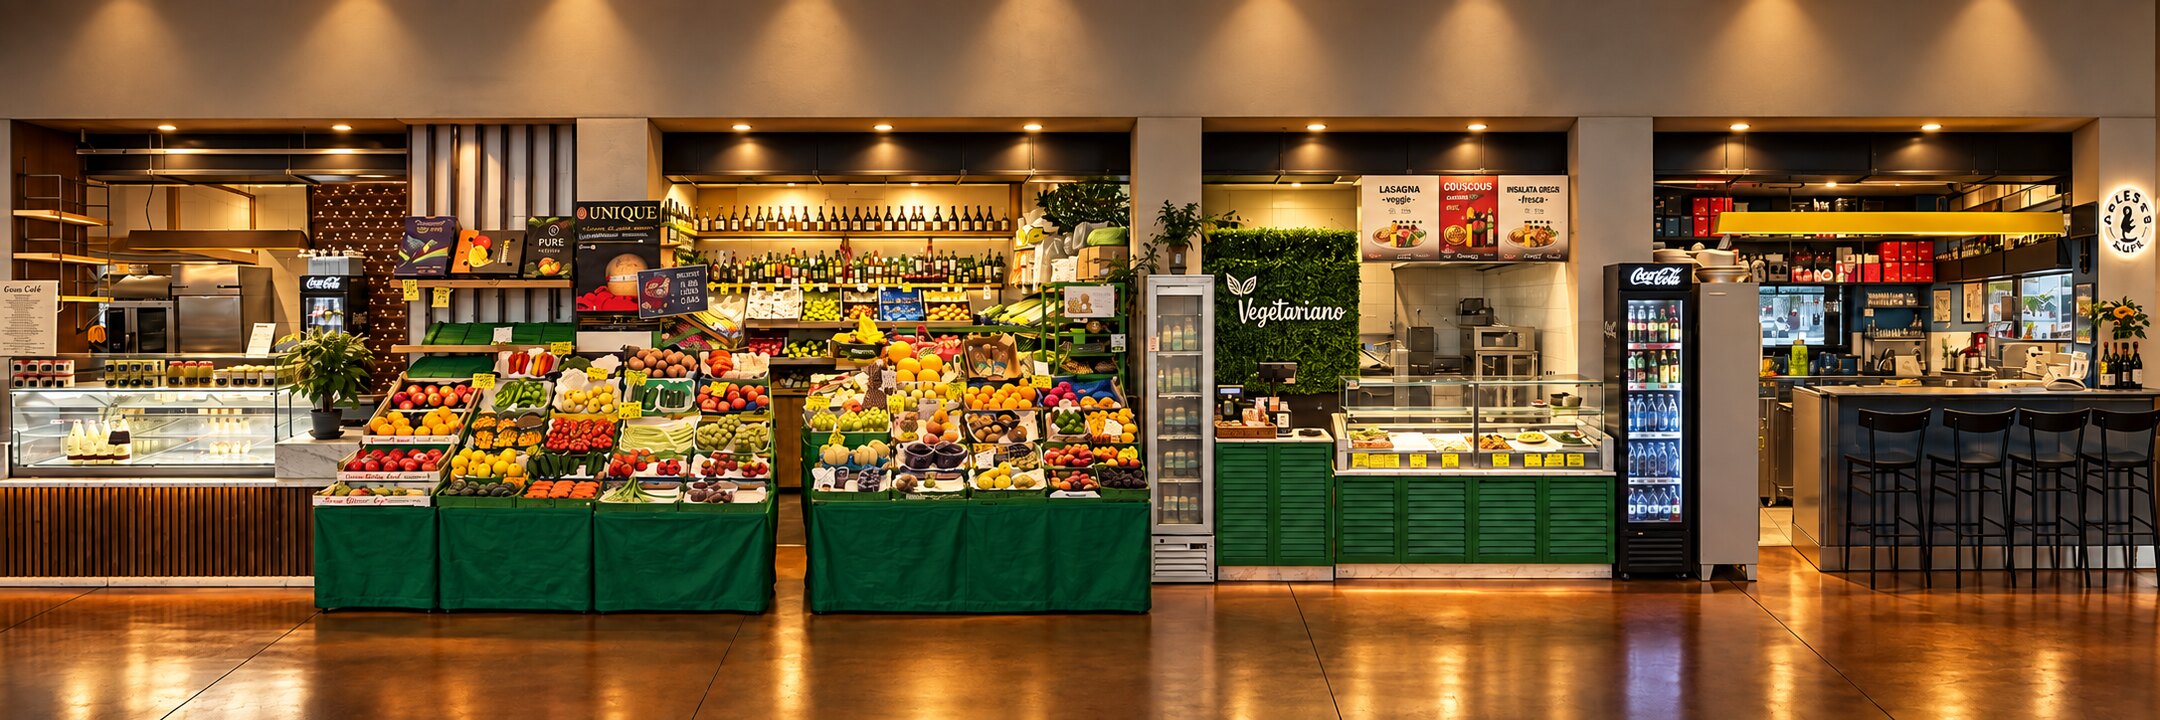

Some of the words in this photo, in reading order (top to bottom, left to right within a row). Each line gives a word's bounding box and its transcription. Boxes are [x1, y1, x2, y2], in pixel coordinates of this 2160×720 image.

[1379, 185, 1421, 194] LASAGNA
[1443, 182, 1493, 192] COUSCOUS
[589, 206, 658, 223] UNIQUE
[538, 238, 565, 247] PURE
[1238, 297, 1347, 328] Vegetariano
